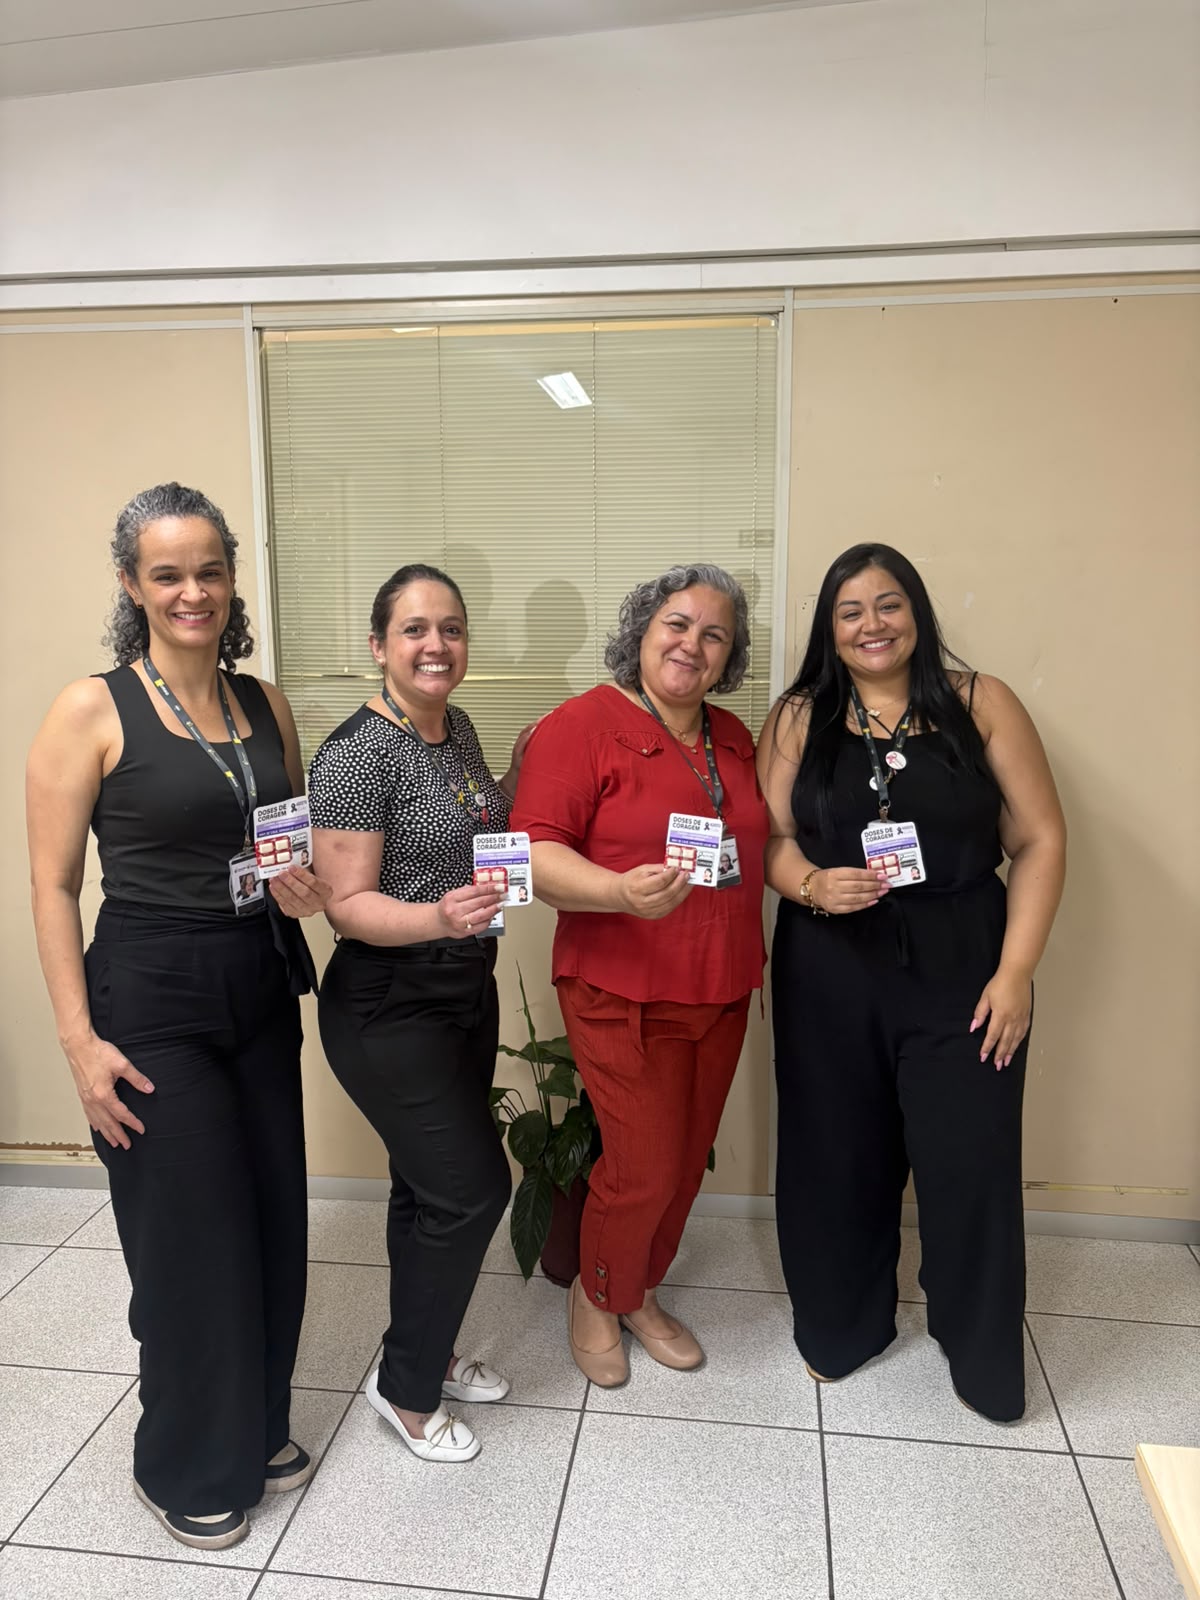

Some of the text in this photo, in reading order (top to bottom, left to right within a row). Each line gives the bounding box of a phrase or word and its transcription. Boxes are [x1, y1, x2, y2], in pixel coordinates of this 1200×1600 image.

[258, 807, 277, 816] DOSES
[258, 811, 286, 822] CORAGEM
[864, 829, 884, 837] DOSES
[865, 833, 893, 842] CORAGEM
